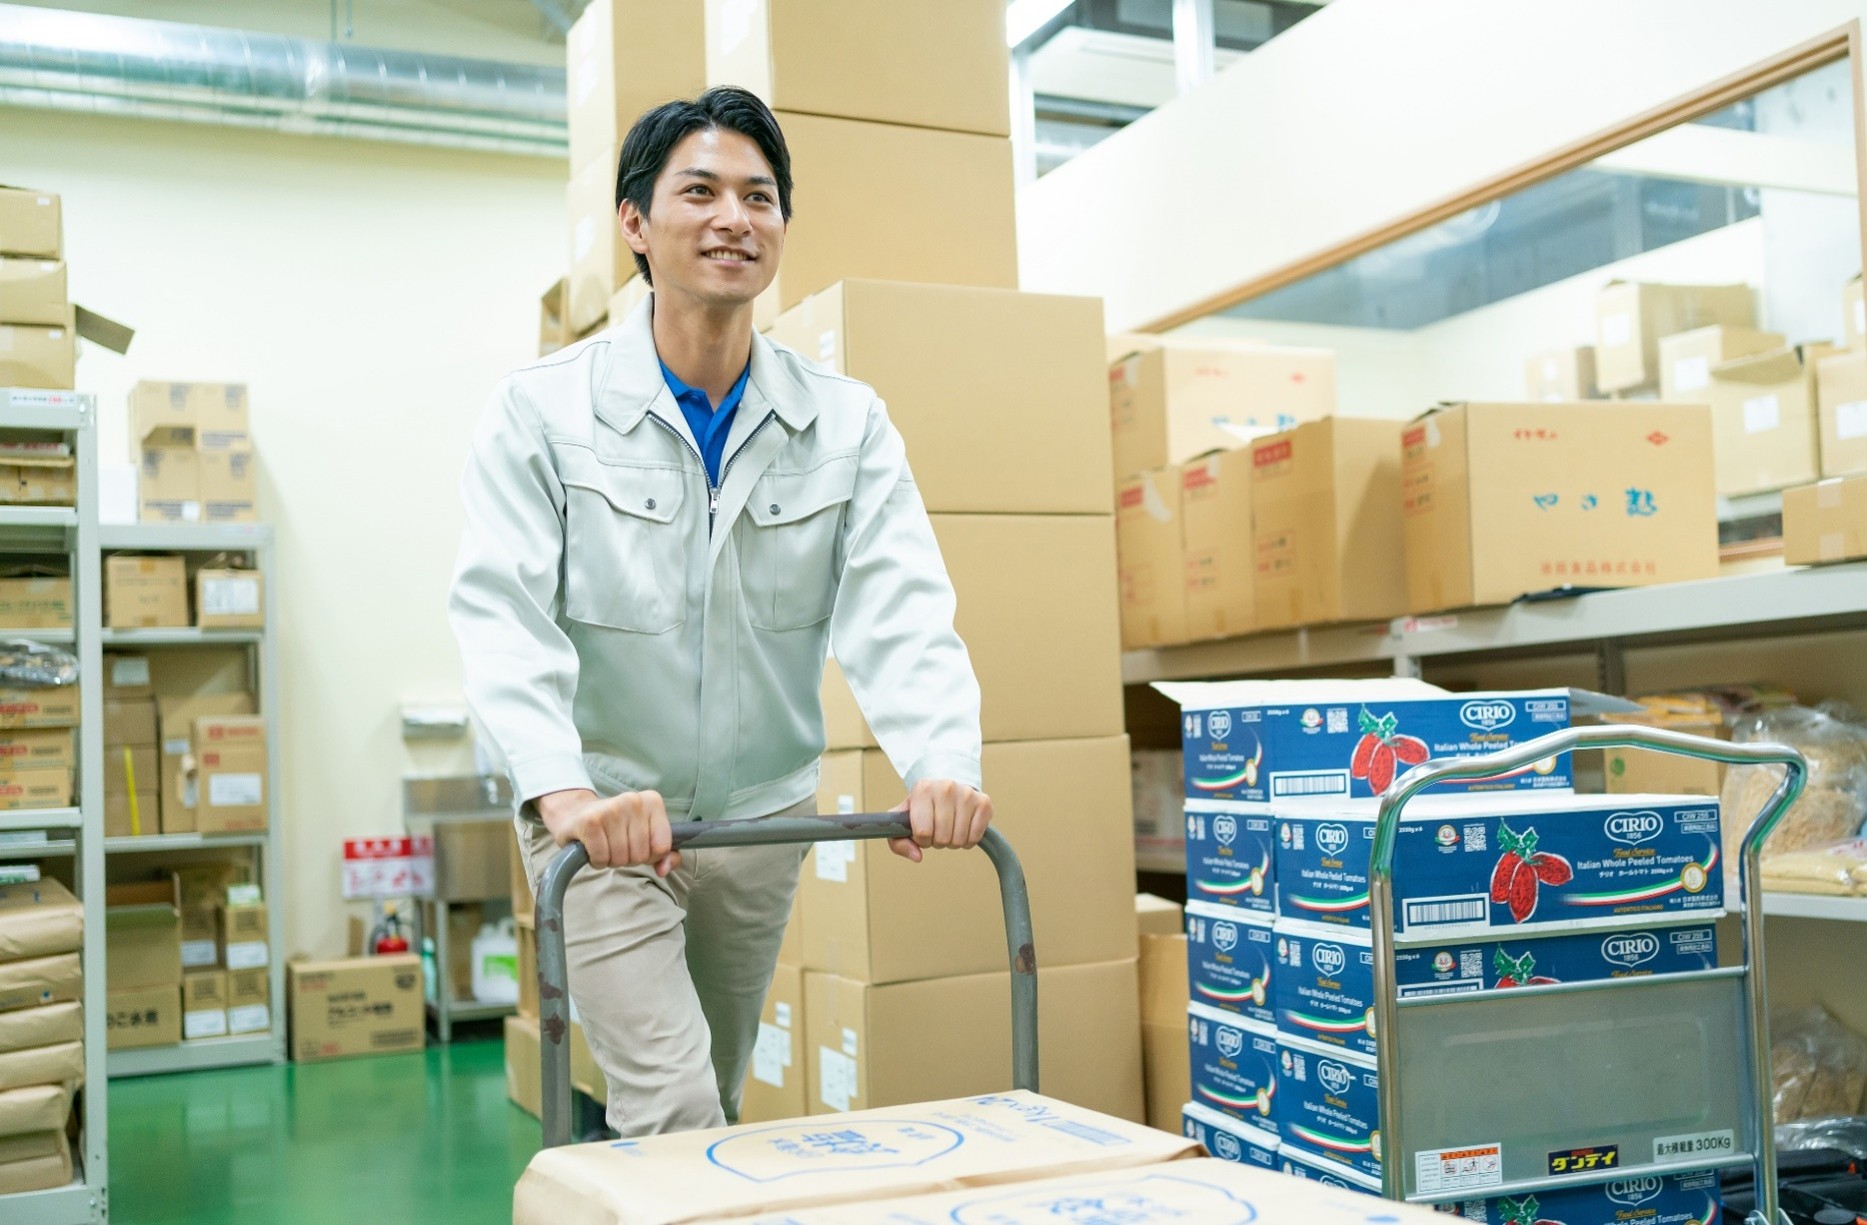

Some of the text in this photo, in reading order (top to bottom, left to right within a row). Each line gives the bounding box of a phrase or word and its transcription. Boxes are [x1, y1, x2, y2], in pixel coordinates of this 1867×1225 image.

[1465, 705, 1510, 720] CIRIO
[1434, 743, 1457, 751] Italian
[1459, 742, 1482, 750] Whole
[1483, 740, 1508, 750] Peeled
[1611, 816, 1657, 833] CIRIO
[1320, 829, 1344, 844] CIRIO
[1577, 855, 1694, 870] Italian Whole Peeled Tomatoes
[1607, 938, 1653, 956] CIRIO
[1316, 948, 1341, 965] CIRIO
[1657, 1136, 1731, 1156] 最大積載量 300Kg
[1611, 1177, 1657, 1195] CIRIO
[1657, 1213, 1693, 1222] Tomatoes
